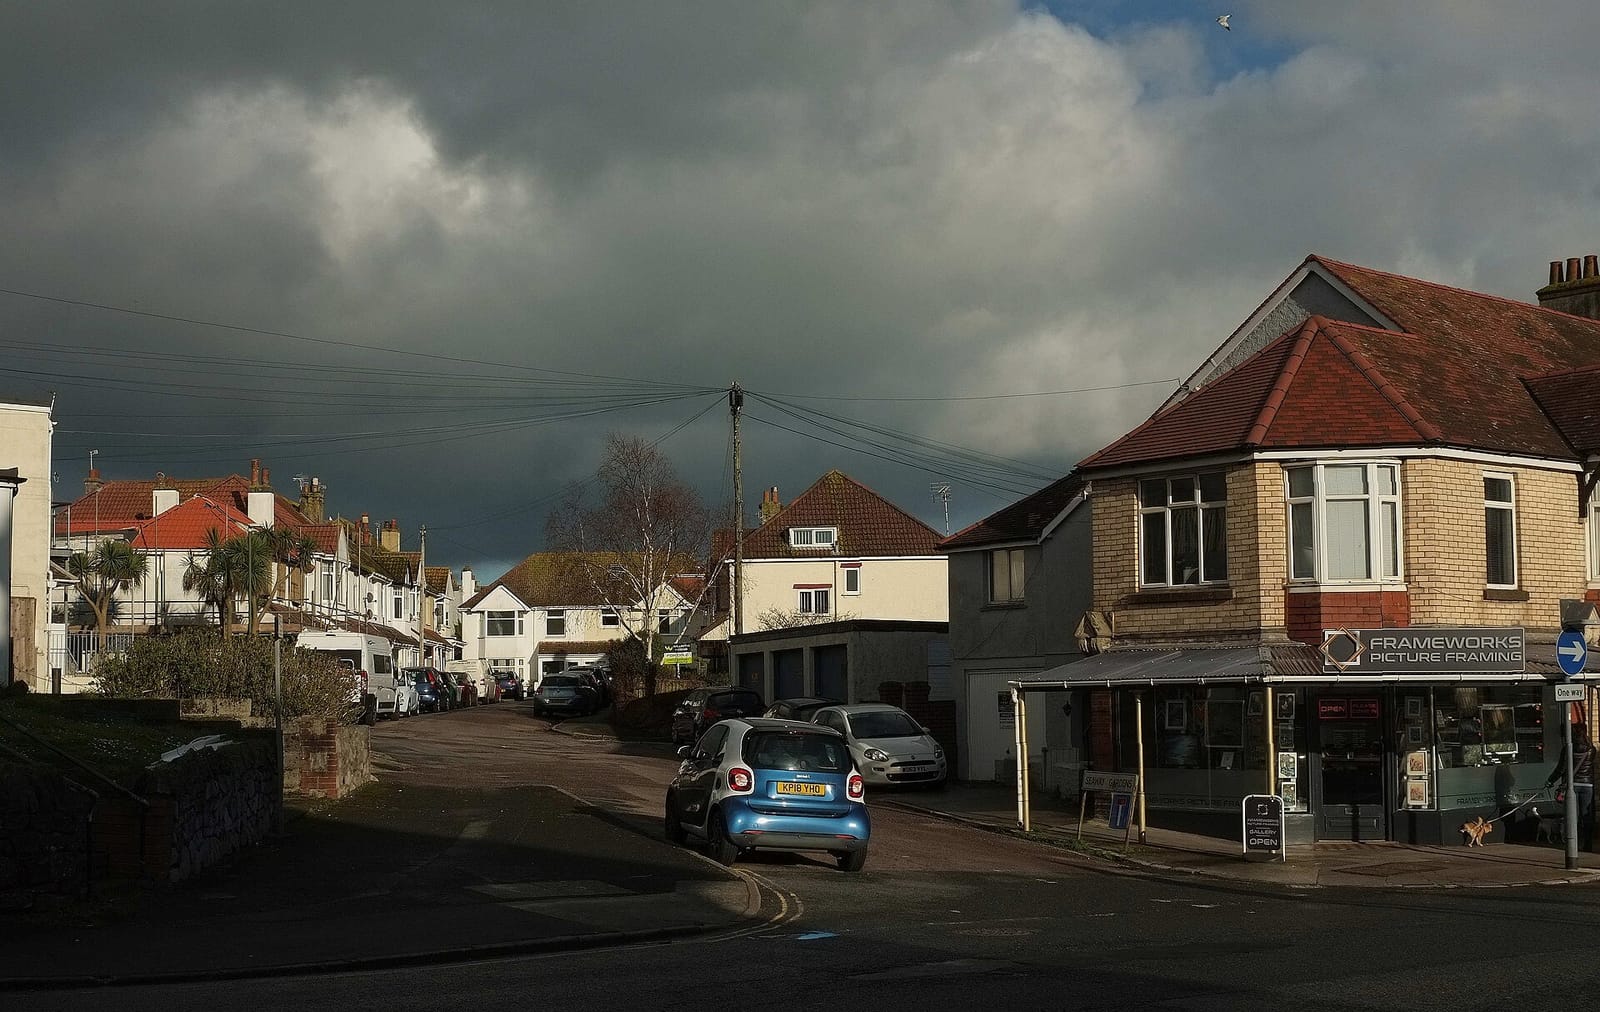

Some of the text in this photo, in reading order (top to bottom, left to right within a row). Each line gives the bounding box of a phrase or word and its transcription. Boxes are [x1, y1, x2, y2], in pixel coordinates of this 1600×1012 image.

[1369, 636, 1522, 650] FRAMEWORKS
[1369, 651, 1522, 663] PICTURE FRAMING
[1557, 688, 1584, 697] One way
[1320, 705, 1345, 713] OPEN
[782, 783, 802, 792] KP18
[1249, 838, 1278, 846] OPEN
